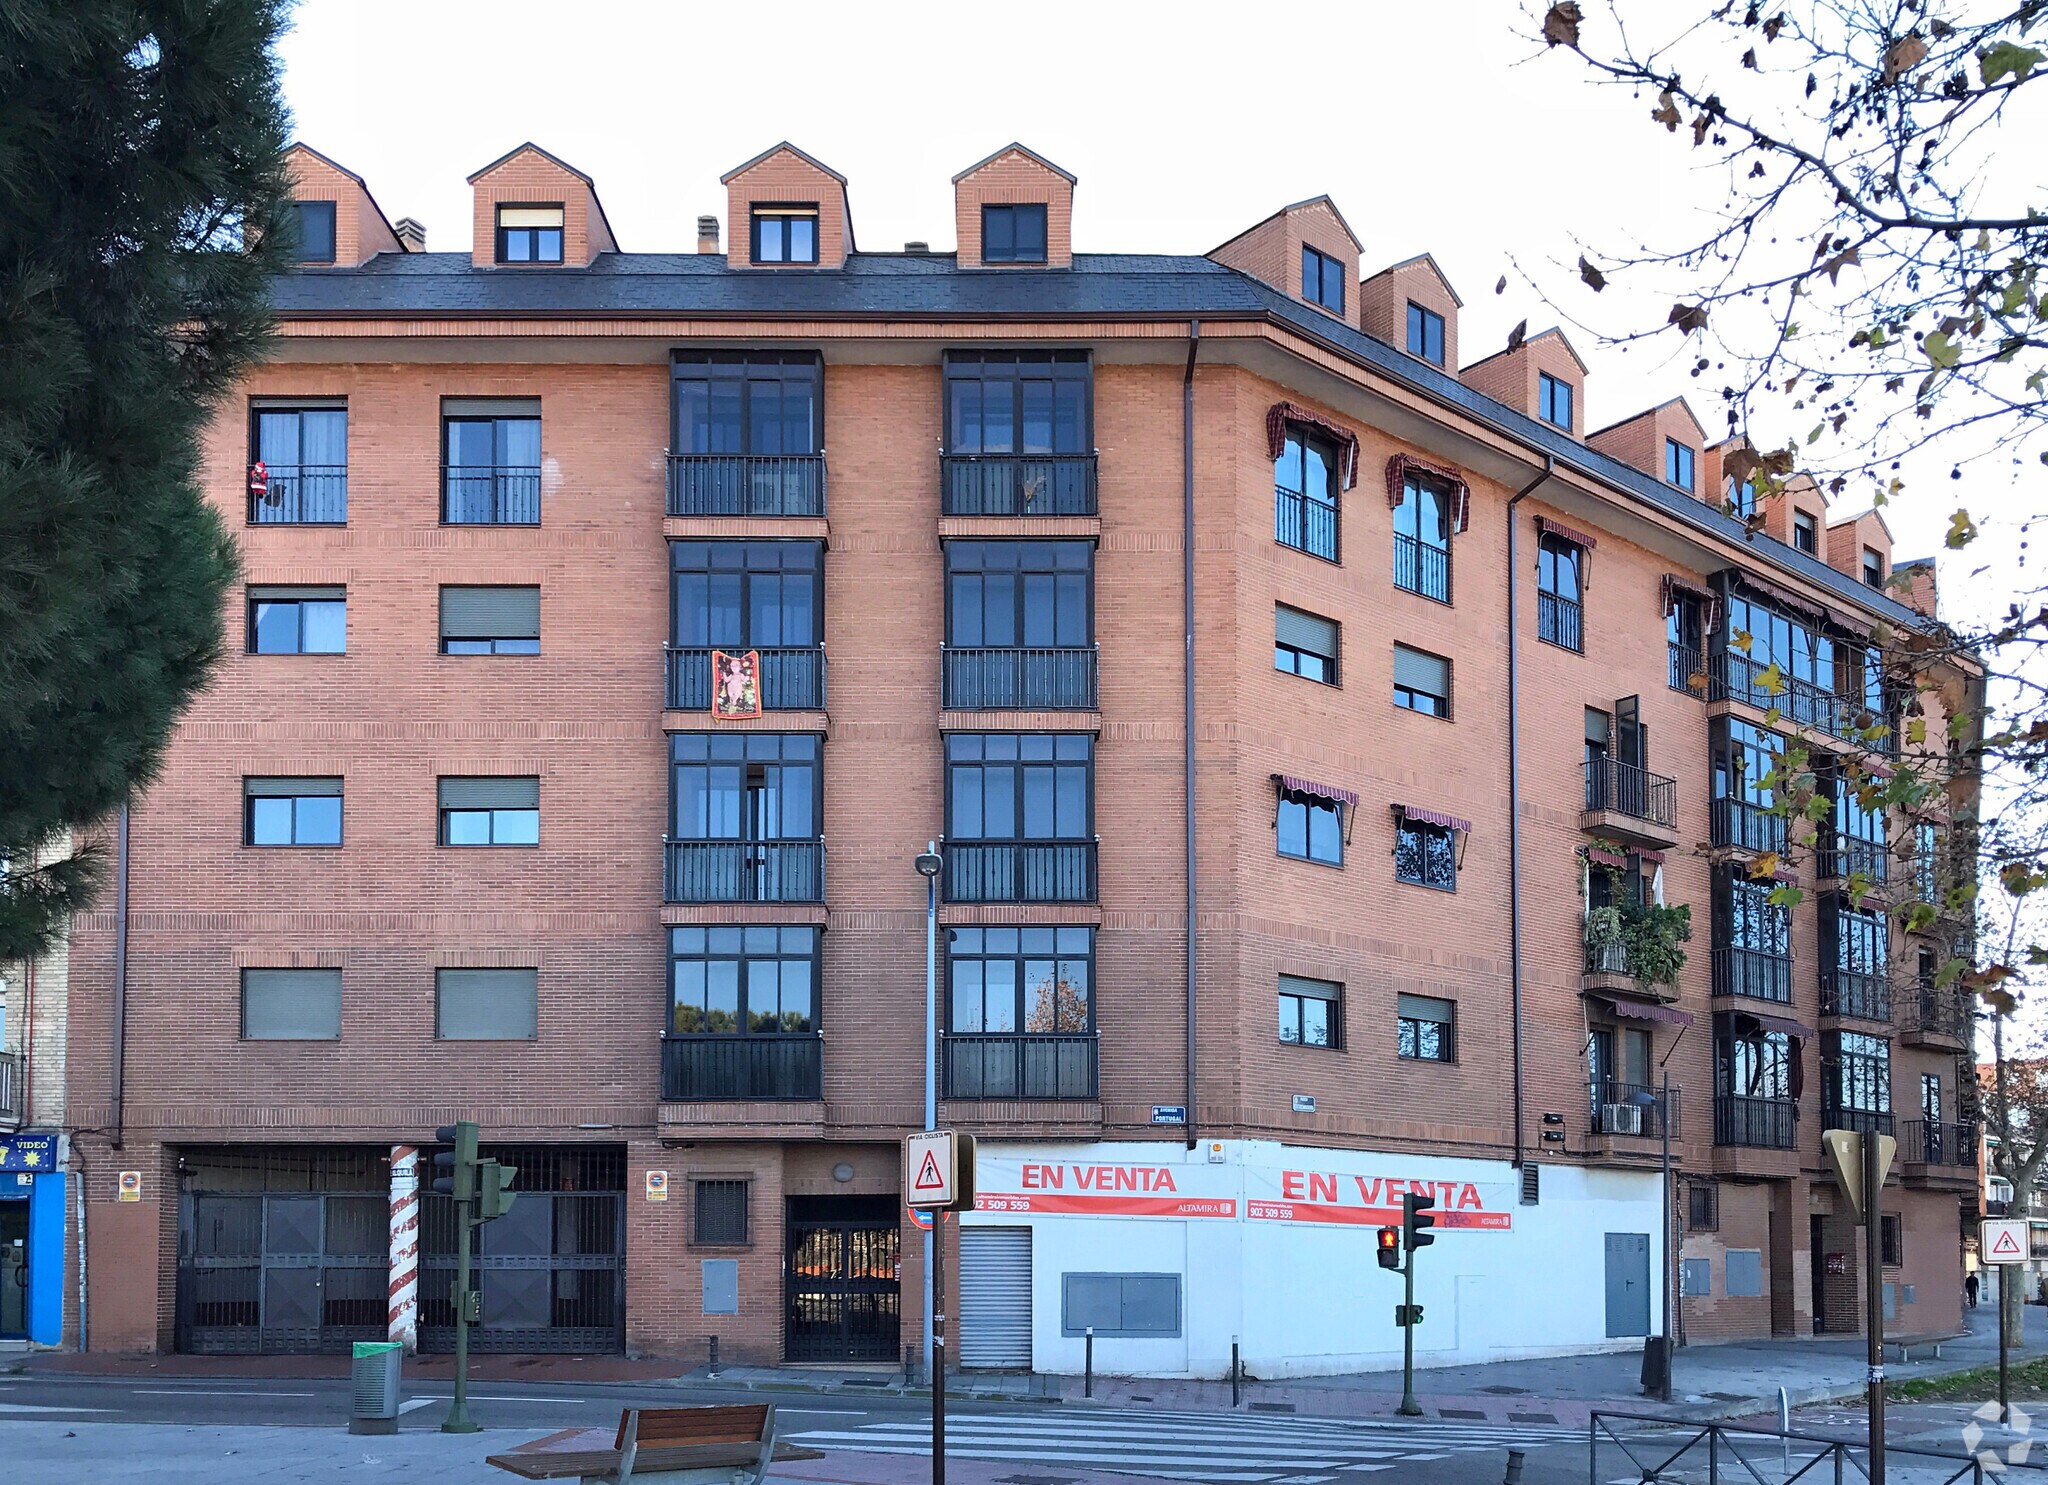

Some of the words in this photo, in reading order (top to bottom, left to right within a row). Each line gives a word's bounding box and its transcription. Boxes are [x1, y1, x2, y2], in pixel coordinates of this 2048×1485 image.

[16, 1141, 49, 1149] VIDEO
[1022, 1164, 1064, 1189] EN
[1072, 1165, 1177, 1192] VENTA
[1282, 1170, 1338, 1203] EN
[1354, 1176, 1484, 1210] VENTA
[987, 1200, 1007, 1210] 509
[1010, 1201, 1030, 1211] 559
[1177, 1203, 1219, 1213] ALTAMIRA
[1250, 1207, 1264, 1217] 902
[1265, 1208, 1279, 1218] 509
[1280, 1209, 1293, 1219] 559
